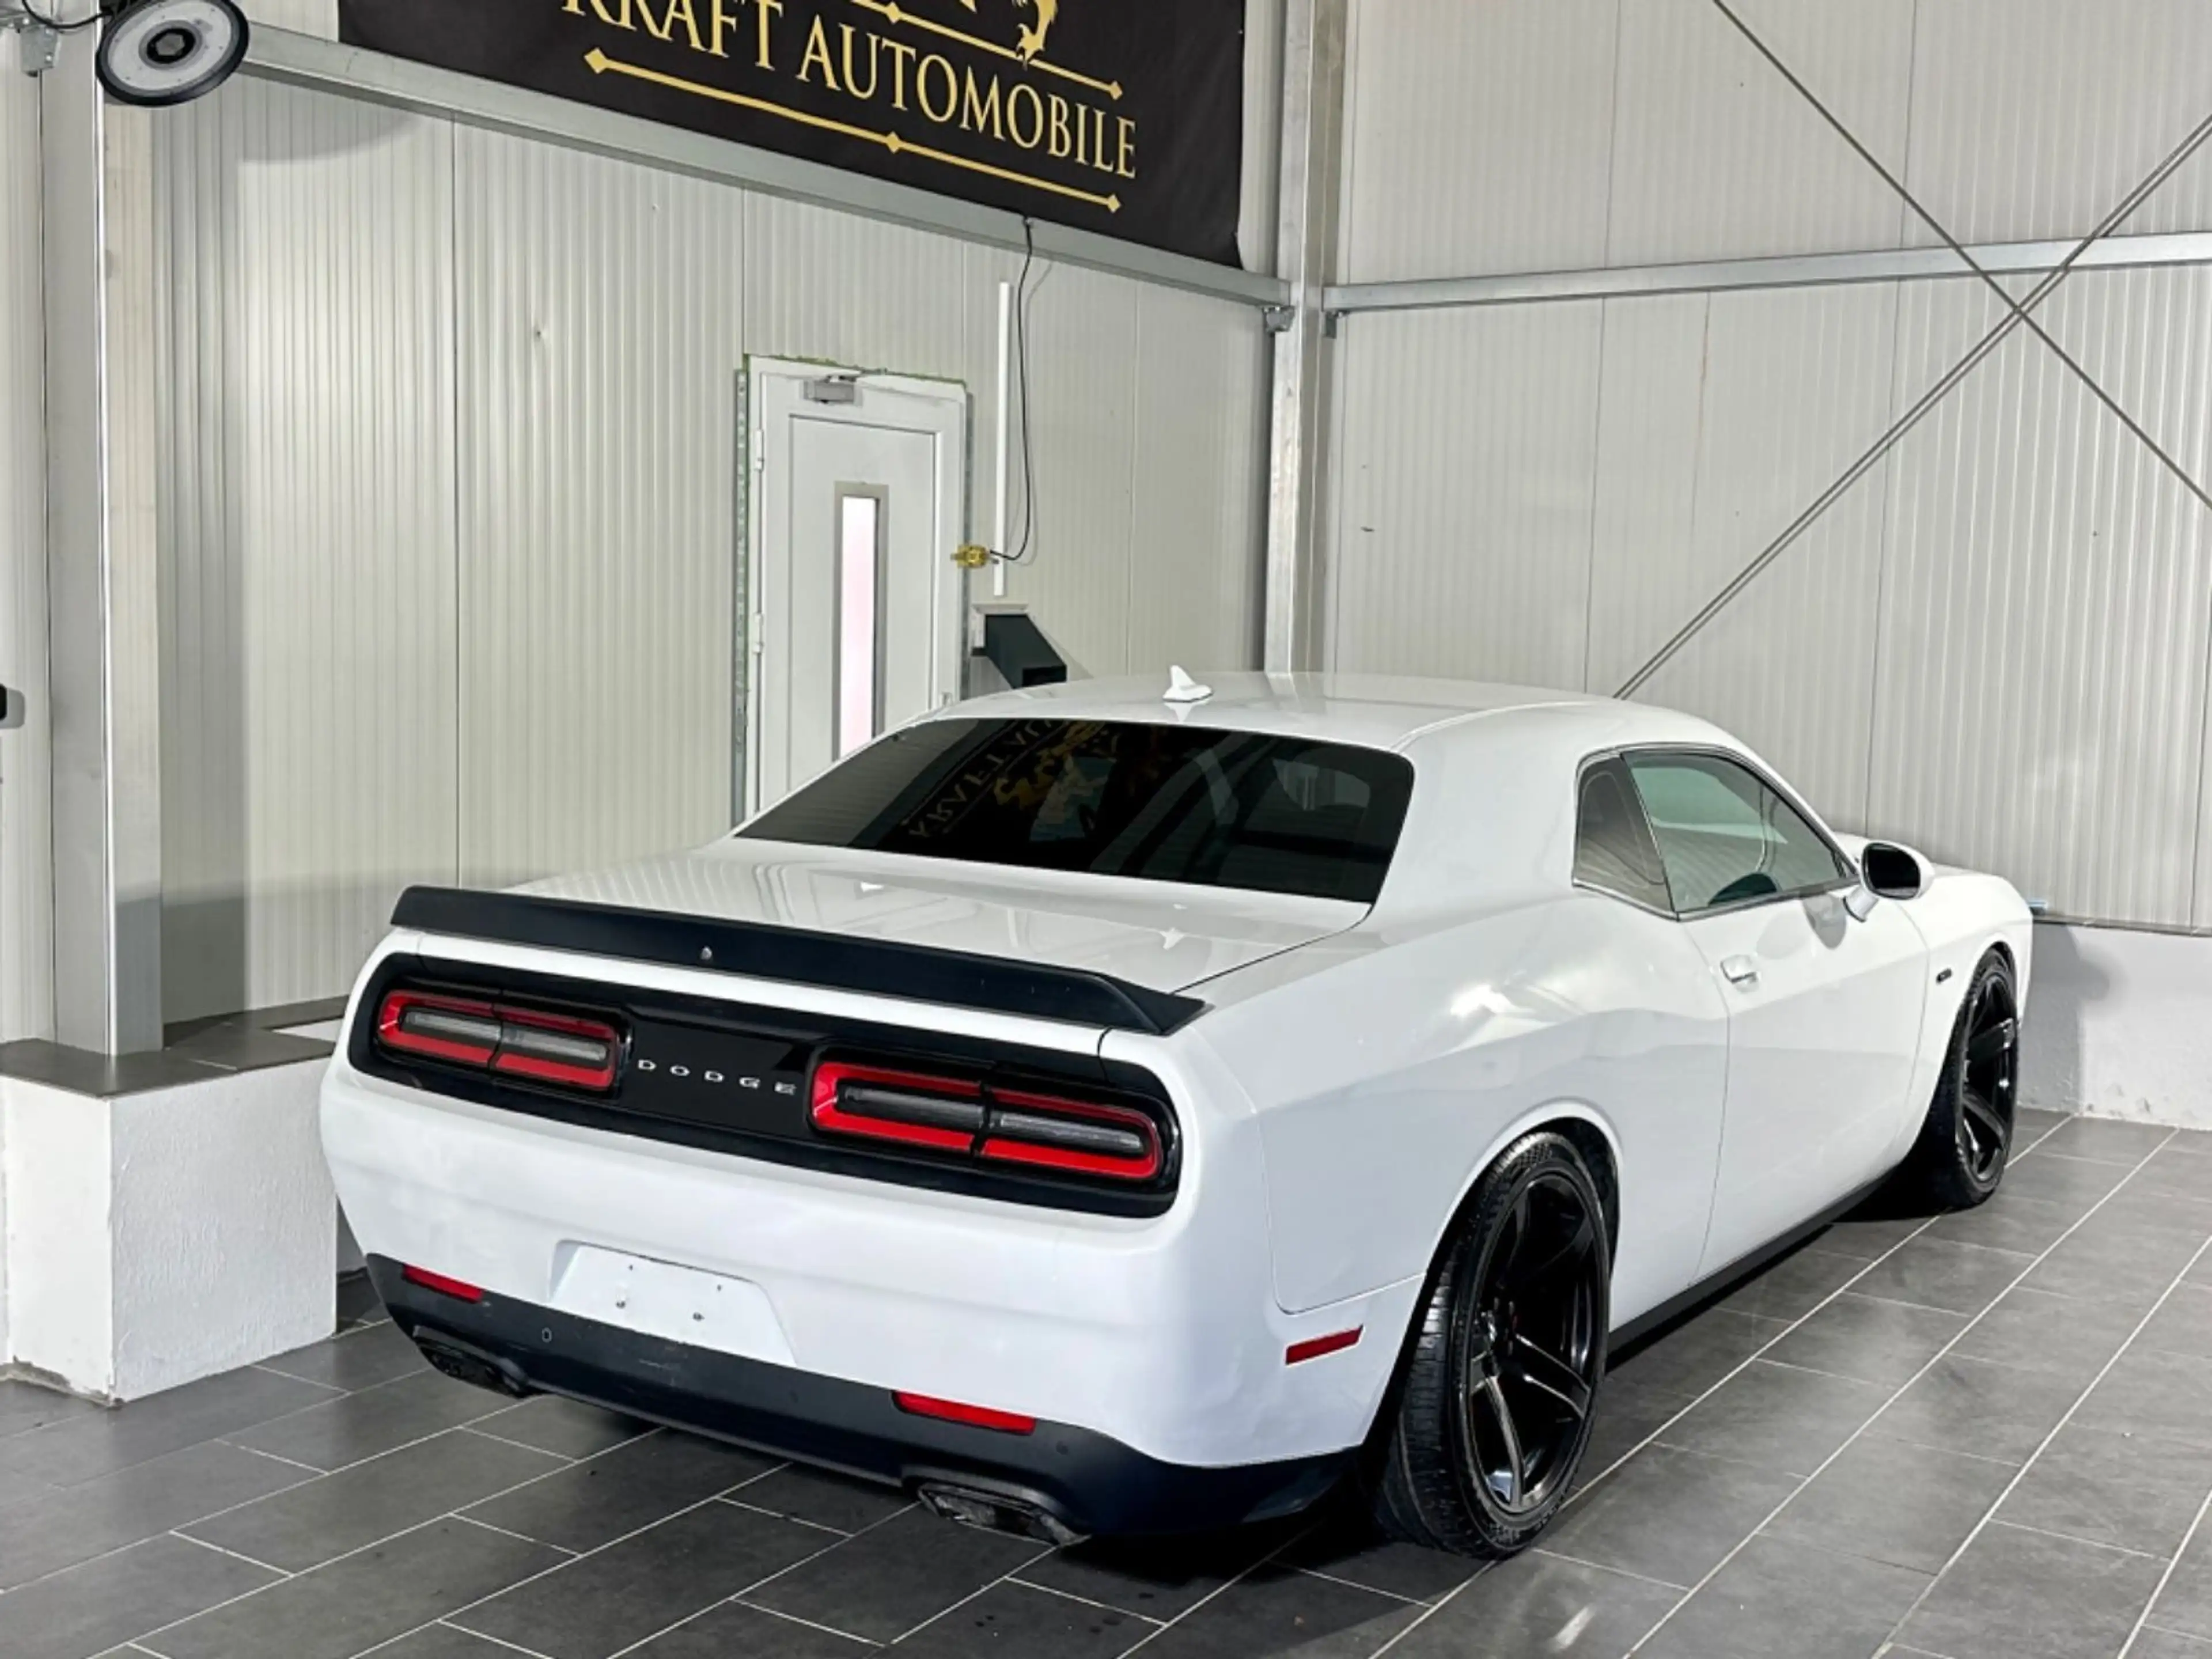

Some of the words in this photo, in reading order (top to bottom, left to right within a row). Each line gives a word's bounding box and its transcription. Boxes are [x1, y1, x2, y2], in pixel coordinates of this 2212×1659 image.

[562, 0, 783, 71] AFT
[796, 14, 1136, 179] AUTOMOBILE
[637, 1059, 797, 1095] DODGE
